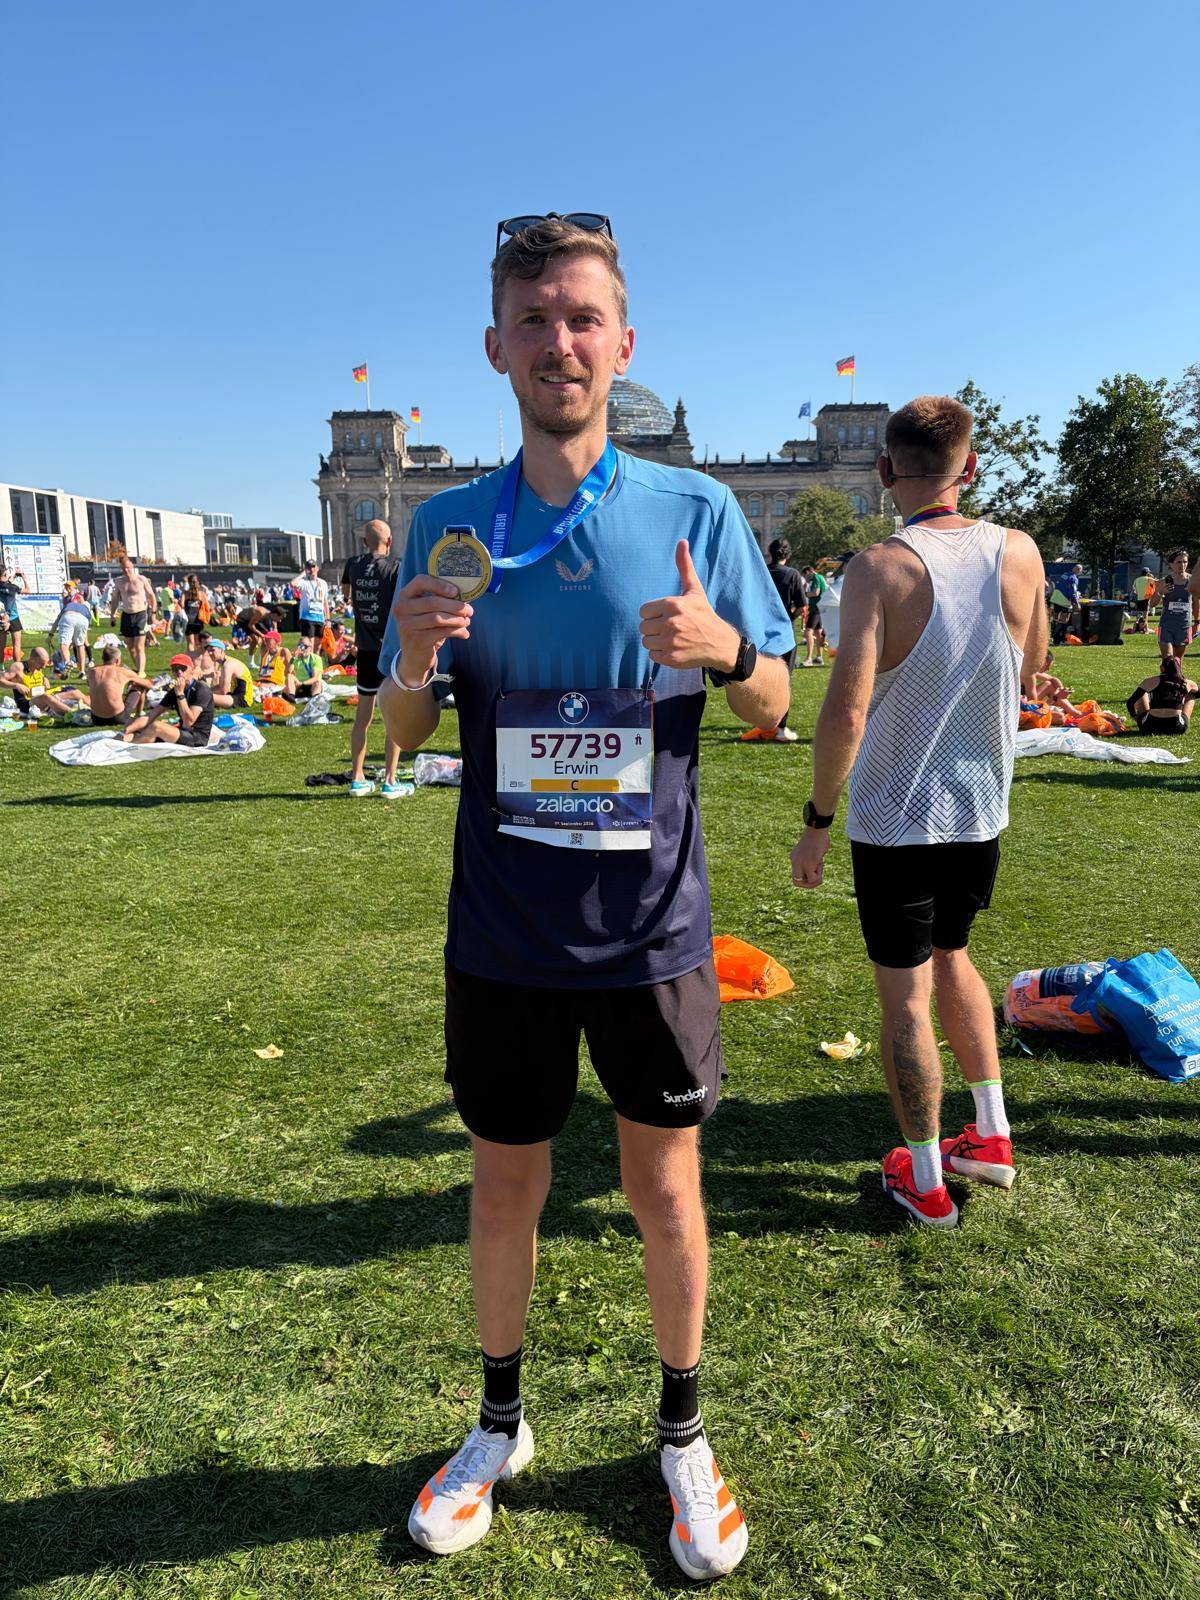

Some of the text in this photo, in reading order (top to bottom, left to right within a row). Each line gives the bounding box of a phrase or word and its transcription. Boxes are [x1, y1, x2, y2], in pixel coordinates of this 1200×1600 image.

[493, 513, 508, 540] BERLIN
[562, 693, 585, 703] BMW
[530, 733, 622, 759] 57739
[554, 760, 598, 775] Erwin
[570, 780, 579, 791] C
[535, 796, 614, 813] zalando
[1143, 993, 1180, 1015] Apply to
[1148, 1009, 1179, 1025] Team
[1157, 1024, 1174, 1037] for
[1174, 1021, 1182, 1029] a
[1167, 1031, 1192, 1049] run a
[663, 1085, 706, 1103] Sunday
